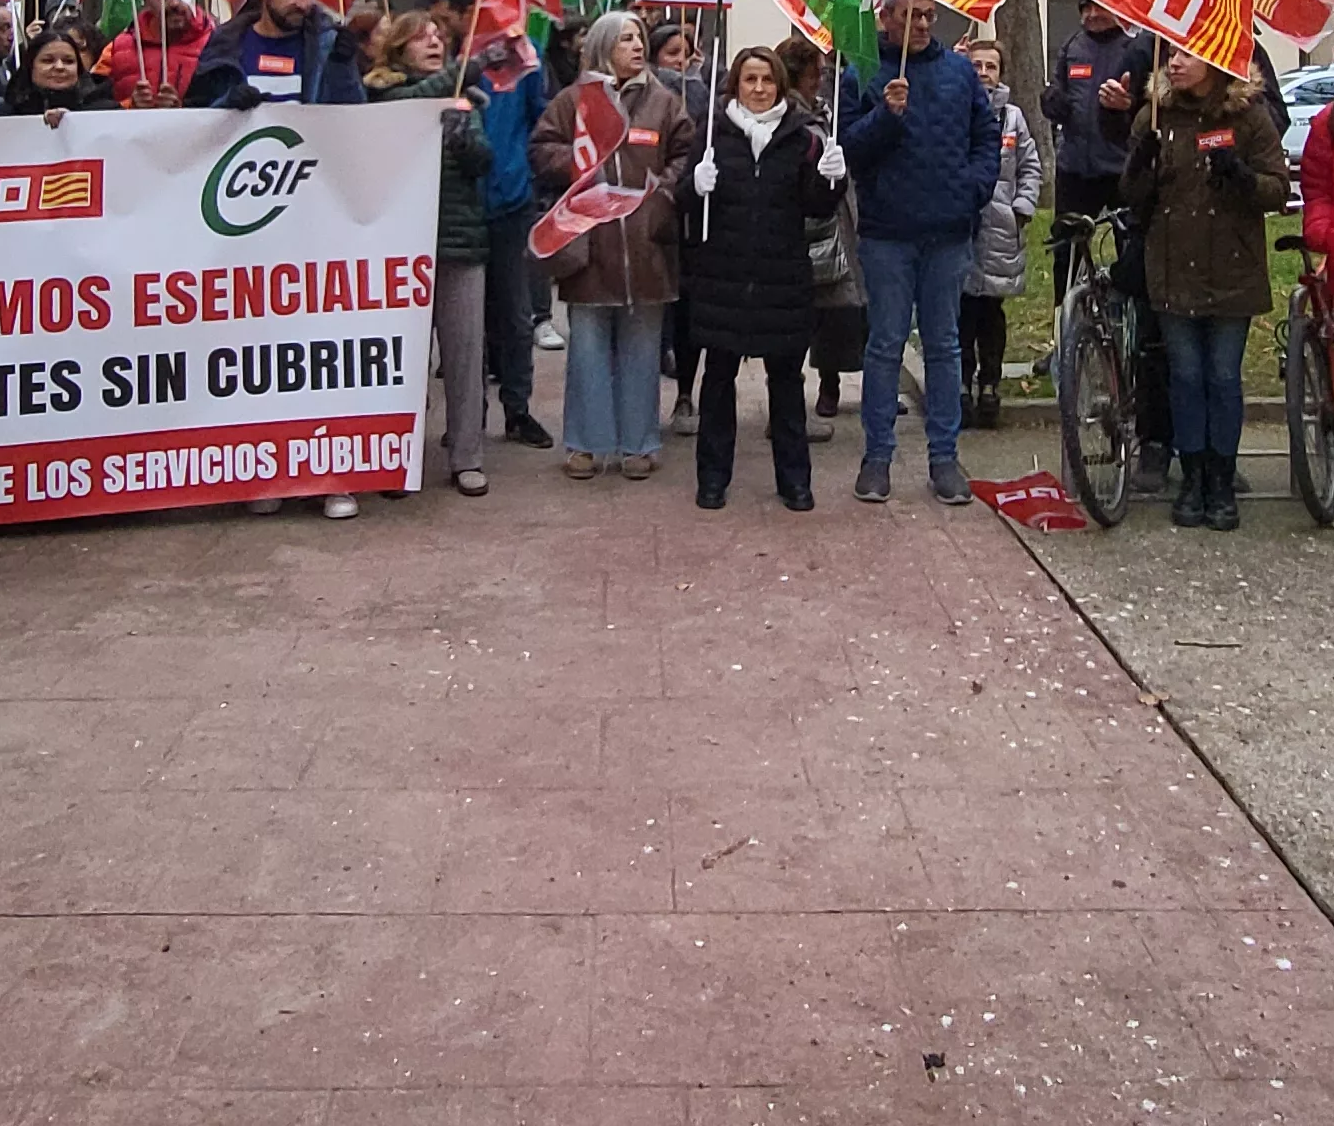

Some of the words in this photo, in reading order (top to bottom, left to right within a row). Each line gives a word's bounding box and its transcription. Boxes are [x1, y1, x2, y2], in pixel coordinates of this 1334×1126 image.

[224, 158, 319, 199] CSIF
[132, 254, 433, 329] ESENCIALES
[101, 351, 187, 409] SIN
[207, 335, 405, 399] CUBRIR!
[27, 457, 92, 501] LOS
[102, 441, 277, 494] SERVICIOS
